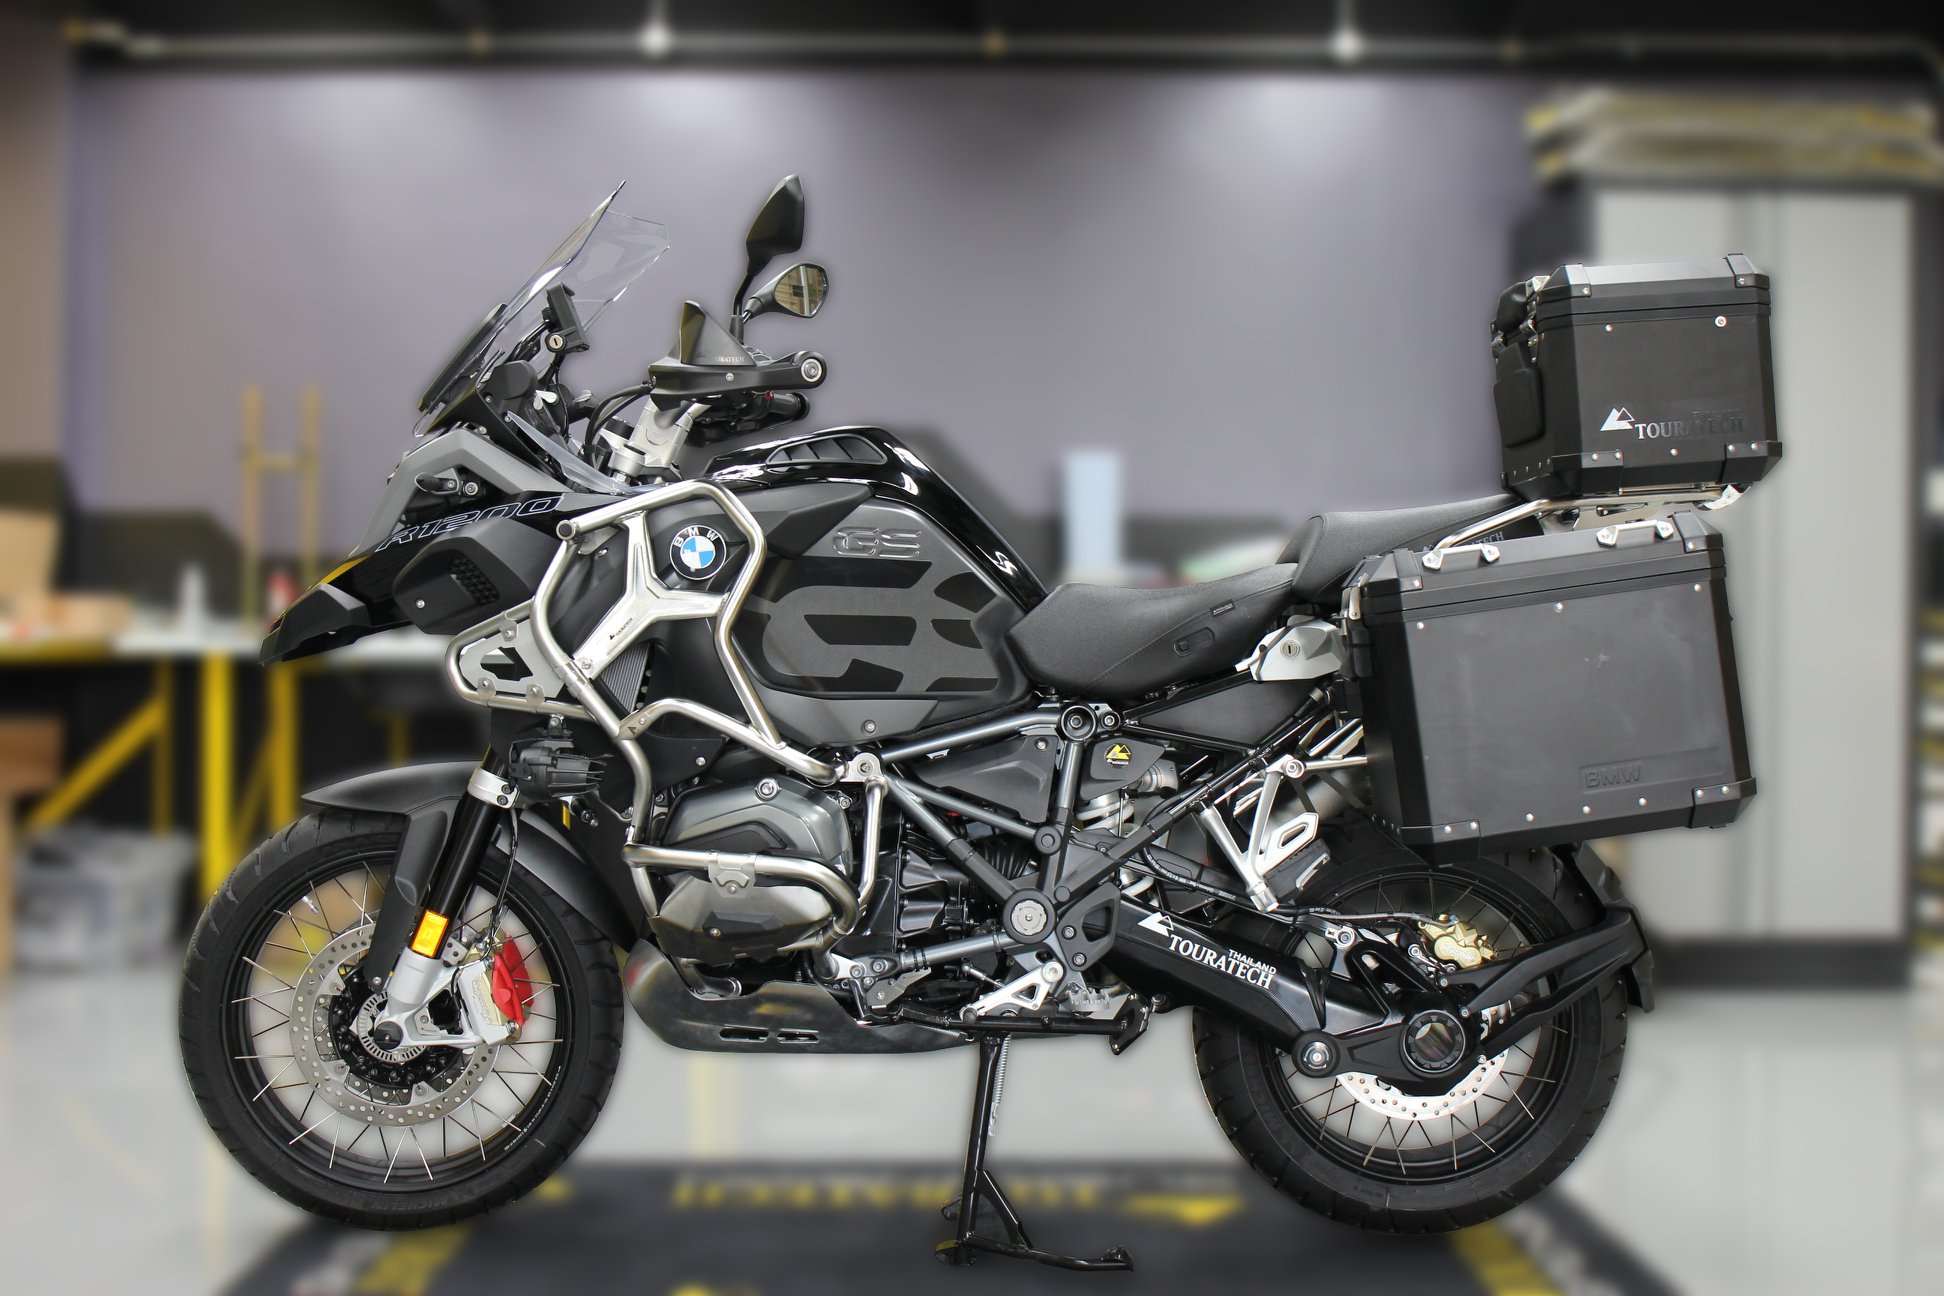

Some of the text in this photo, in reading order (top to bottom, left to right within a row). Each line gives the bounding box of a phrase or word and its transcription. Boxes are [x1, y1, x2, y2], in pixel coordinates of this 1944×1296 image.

[1635, 417, 1743, 440] TOURTECH
[375, 493, 564, 552] R1200
[673, 526, 719, 548] BMW
[833, 526, 922, 558] GS
[1585, 764, 1641, 788] BMW
[1168, 933, 1275, 989] TOURATECH
[1228, 948, 1277, 975] THAILAND
